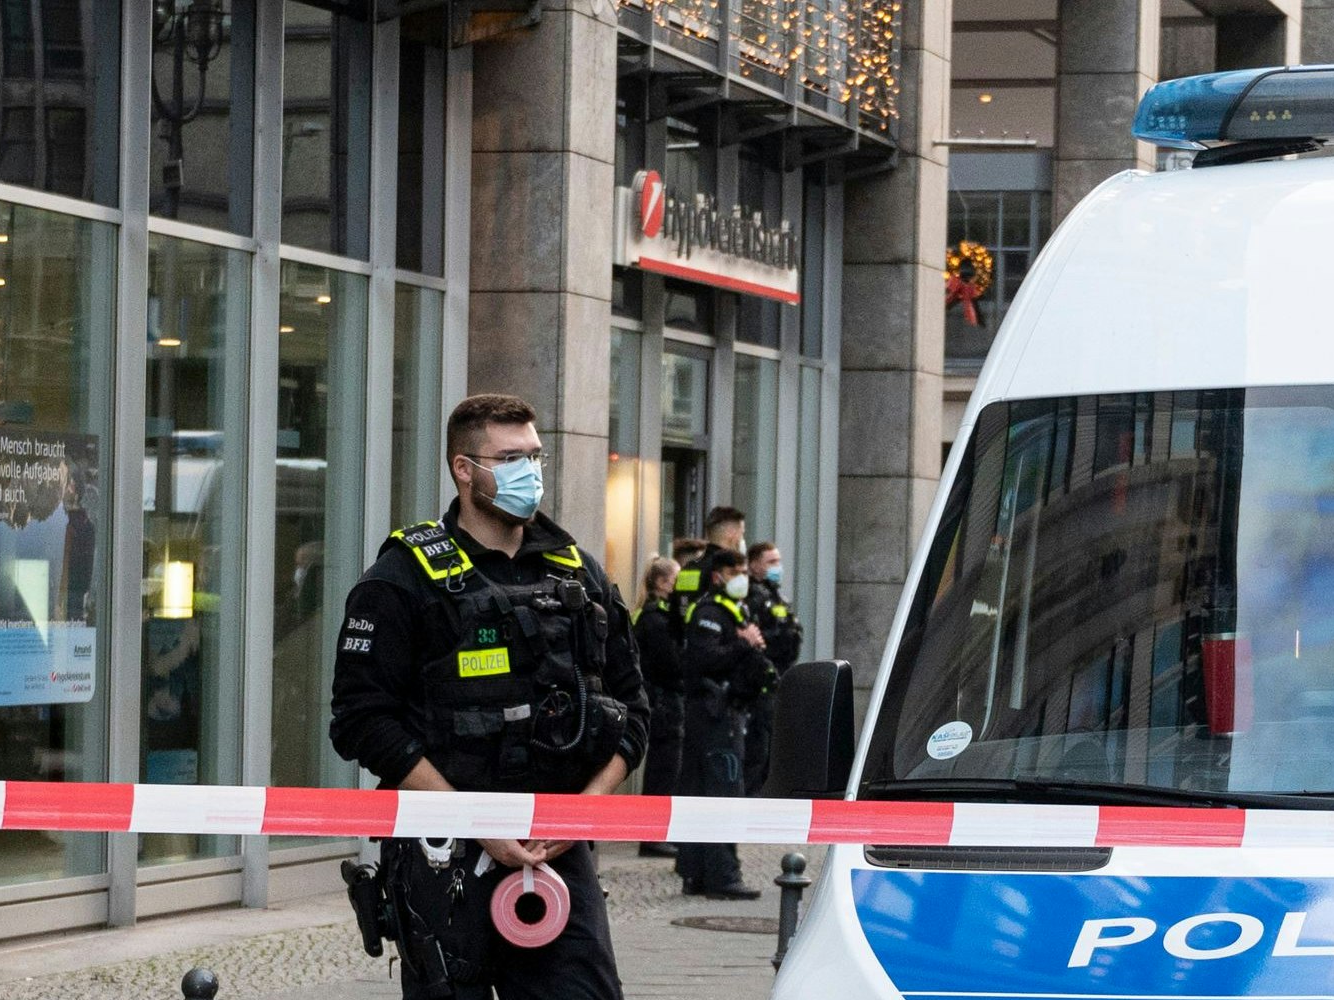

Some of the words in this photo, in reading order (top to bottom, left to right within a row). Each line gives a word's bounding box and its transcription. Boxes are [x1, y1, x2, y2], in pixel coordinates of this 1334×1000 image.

[0, 436, 32, 456] Mensch
[34, 438, 66, 458] braucht
[5, 485, 27, 503] auch.
[424, 540, 454, 557] BFE
[347, 618, 375, 632] BeDo
[478, 628, 497, 643] 33
[343, 638, 372, 652] BFE
[462, 653, 507, 672] POLIZEI
